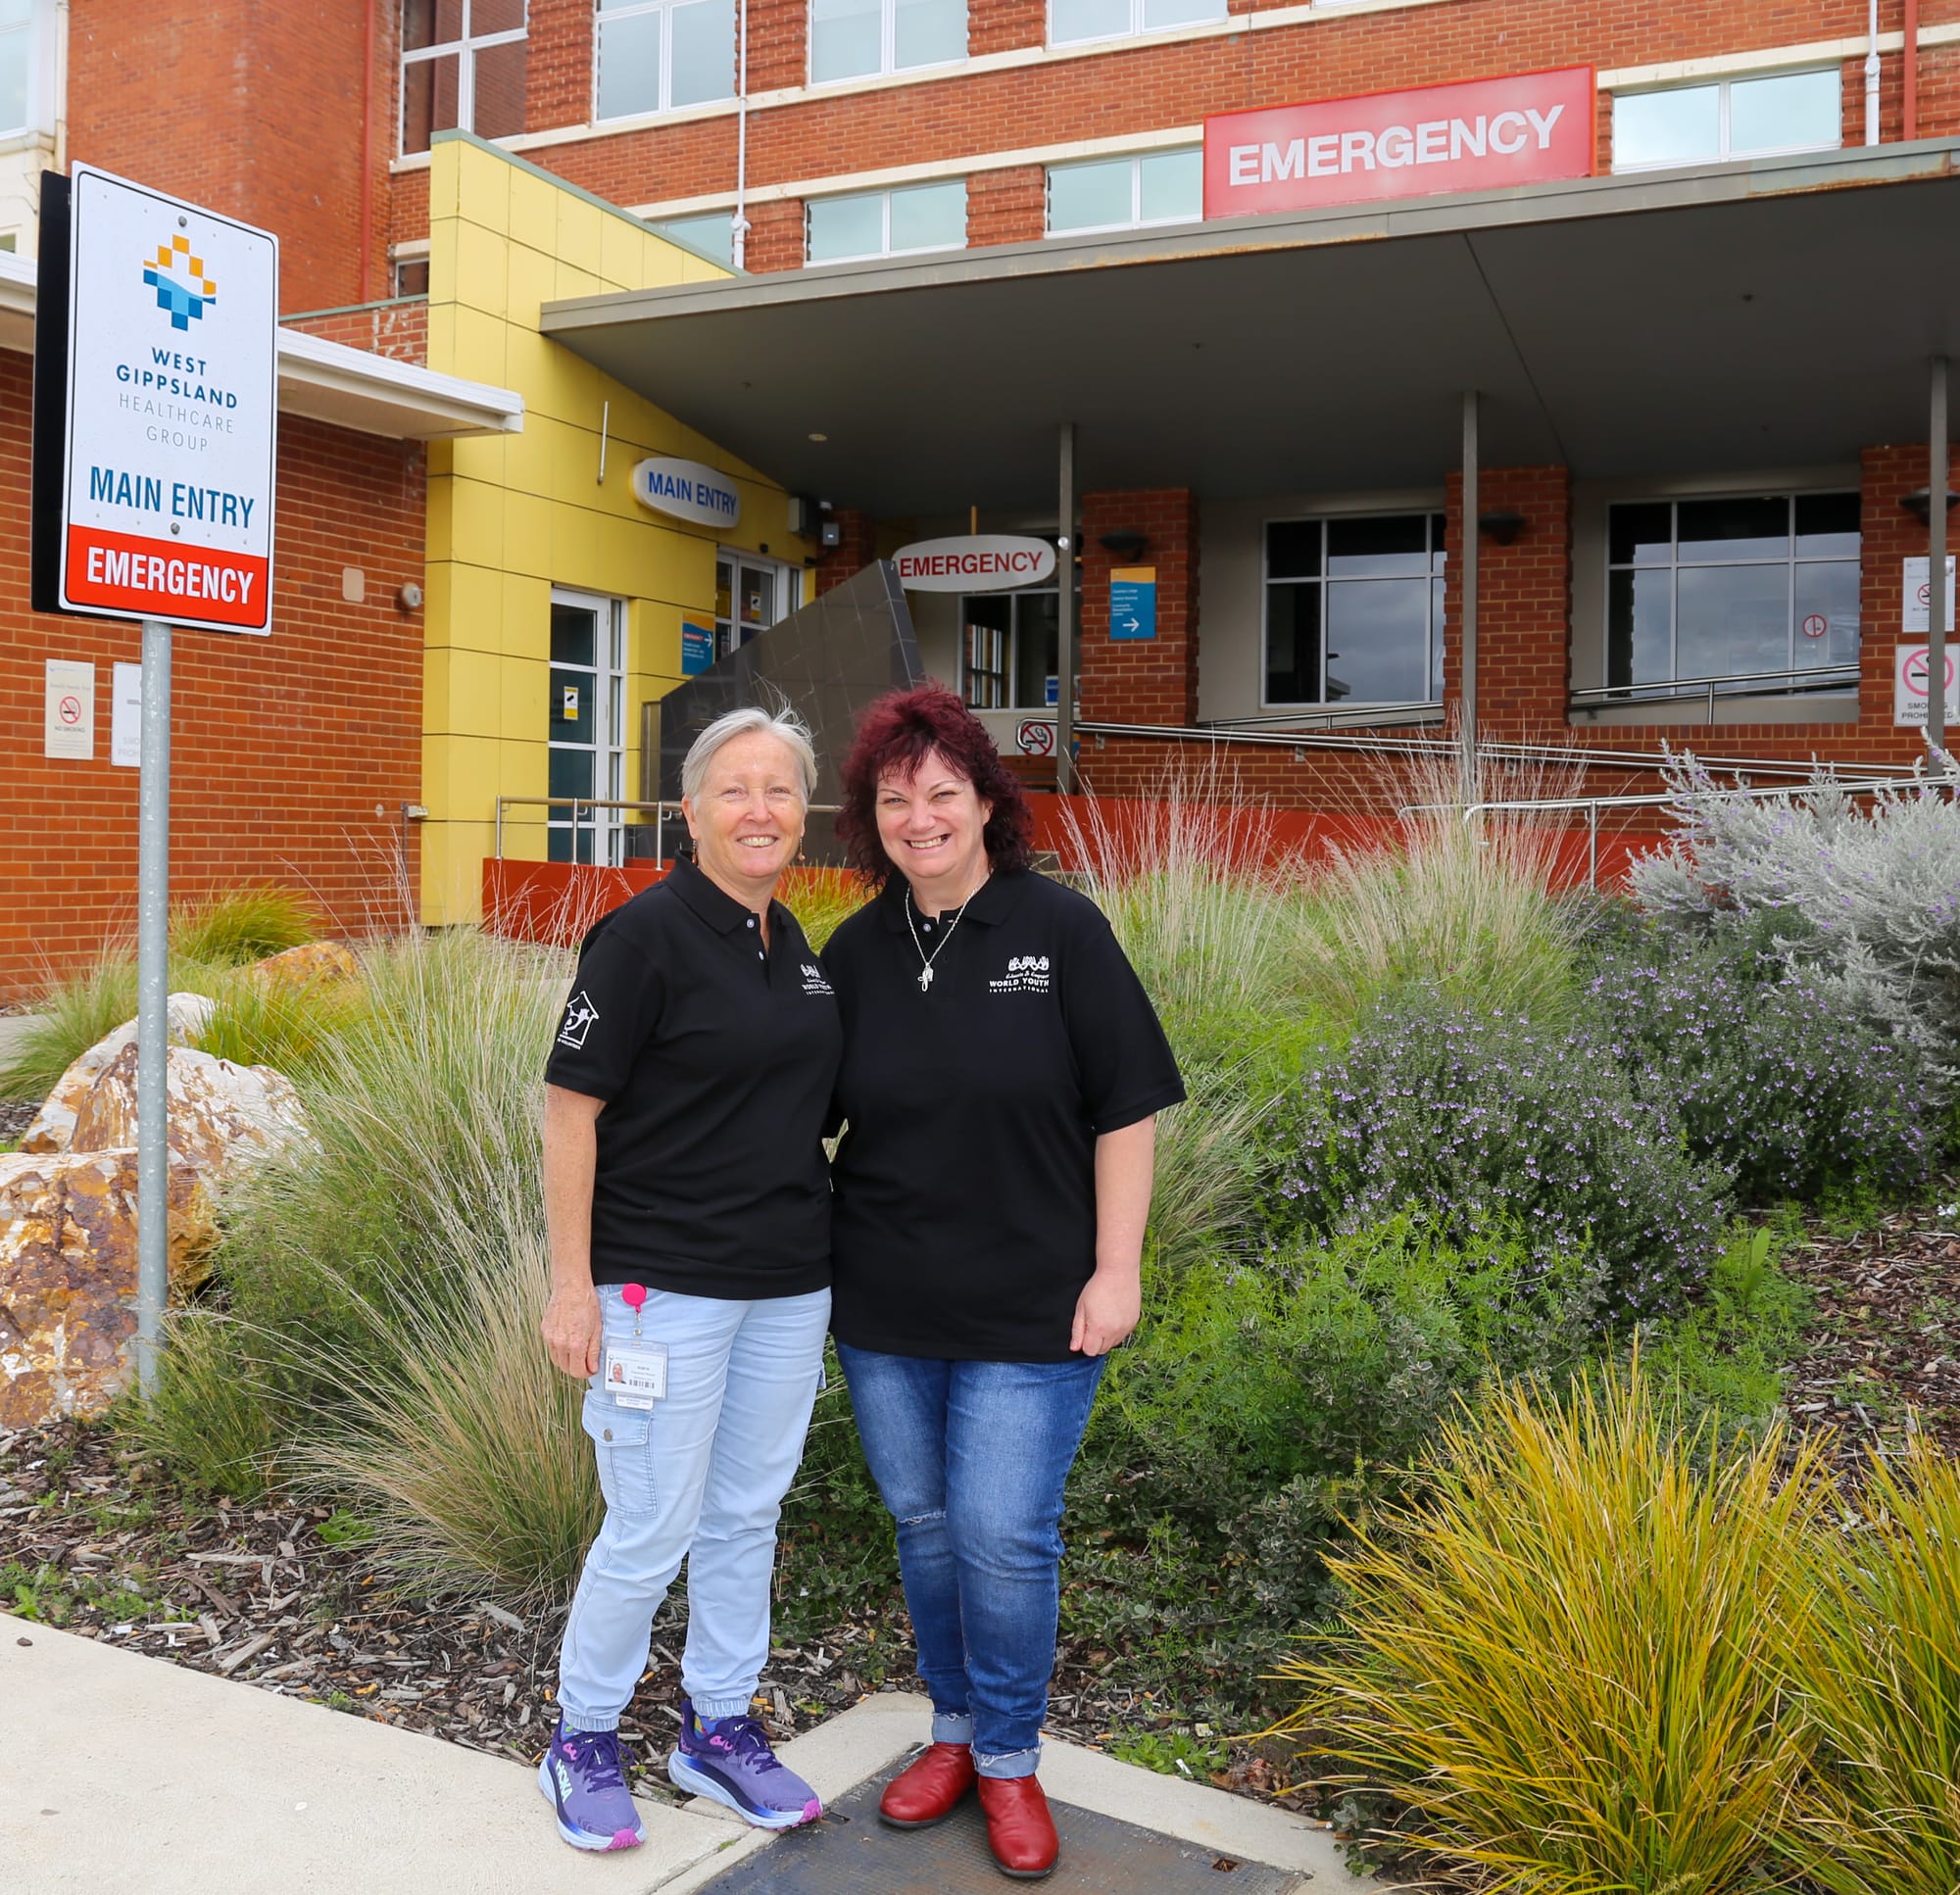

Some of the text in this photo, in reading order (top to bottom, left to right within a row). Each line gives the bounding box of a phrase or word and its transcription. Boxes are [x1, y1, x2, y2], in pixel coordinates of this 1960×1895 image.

[1229, 104, 1564, 186] EMERGENCY
[152, 346, 207, 376] WEST
[116, 364, 237, 409] GIPPSLAND
[120, 392, 234, 434] HEALTHCARE
[146, 425, 208, 452] GROUP
[89, 465, 255, 529] MAIN ENTRY
[649, 471, 737, 516] MAIN ENTRY
[86, 546, 255, 605] EMERGENCY
[900, 552, 1043, 577] EMERGENCY
[989, 977, 1050, 988] WORLD YOUTH
[556, 1758, 573, 1804] HOKA
